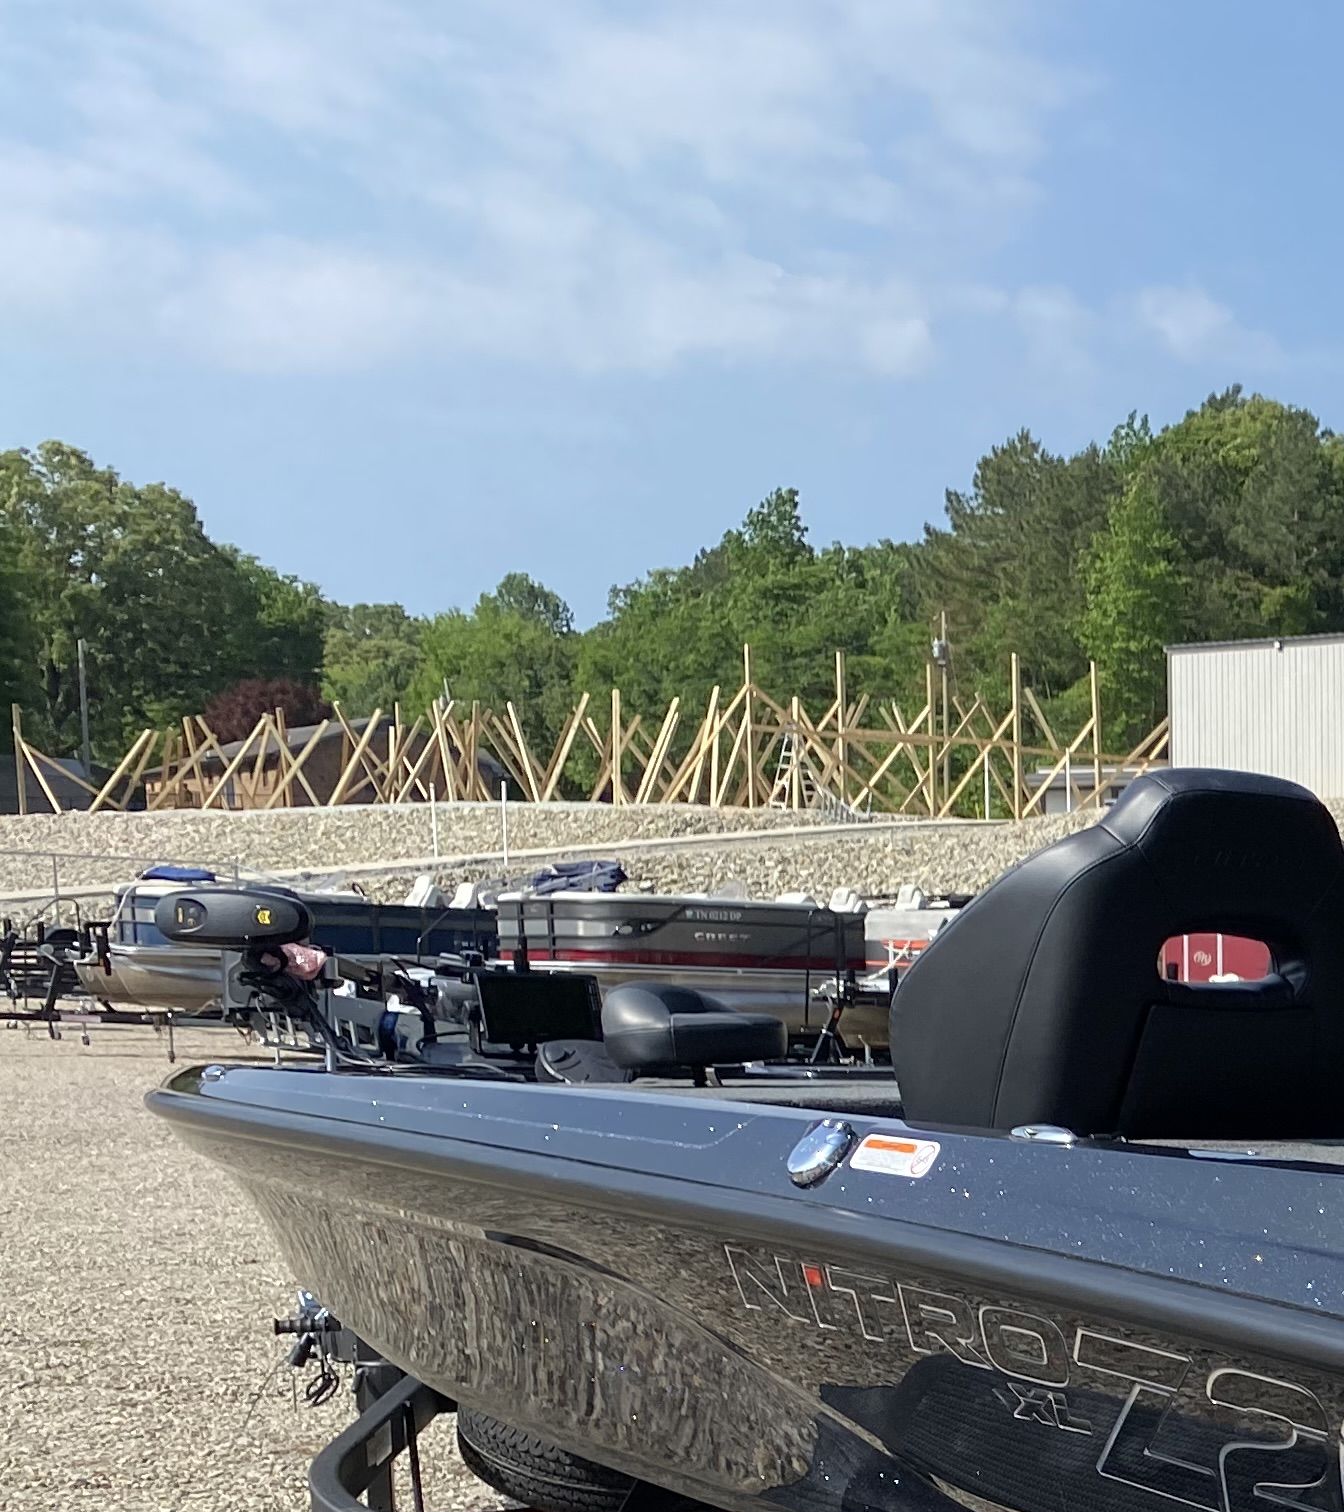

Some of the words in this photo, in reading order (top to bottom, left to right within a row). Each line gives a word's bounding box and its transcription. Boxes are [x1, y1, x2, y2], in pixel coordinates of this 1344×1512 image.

[694, 931, 752, 943] CREST
[723, 1243, 1070, 1388] NITRO
[991, 1382, 1093, 1436] XL
